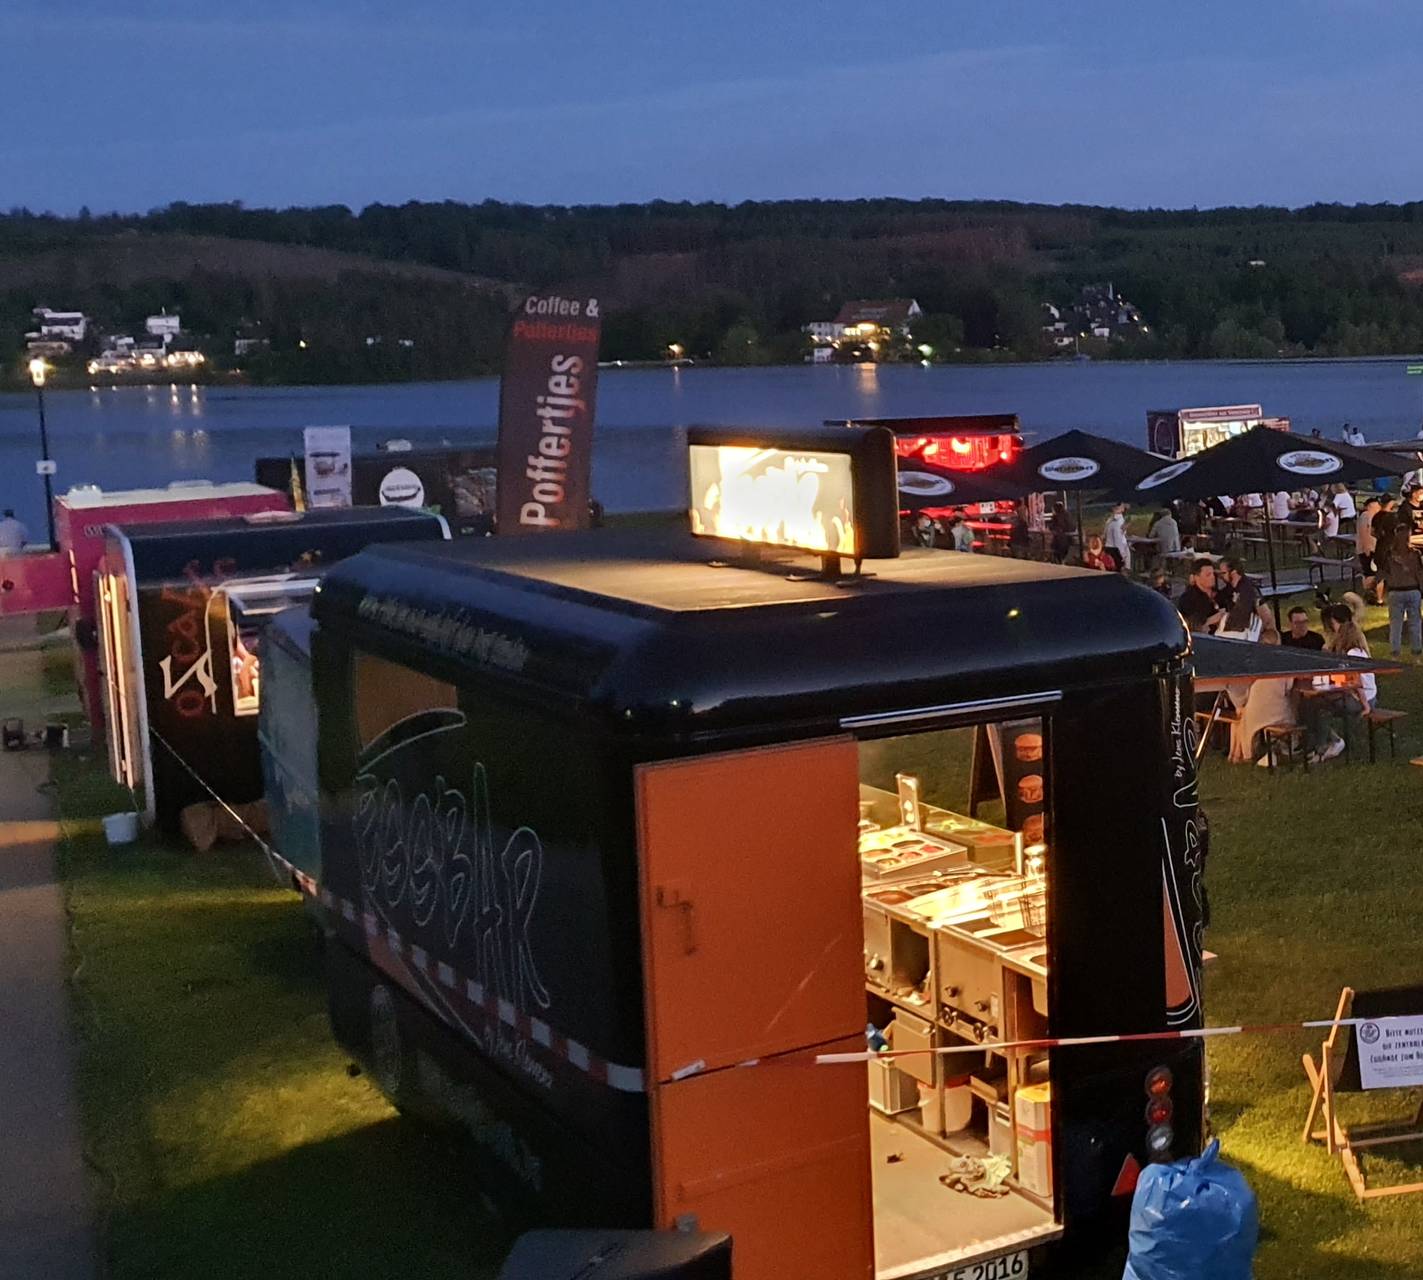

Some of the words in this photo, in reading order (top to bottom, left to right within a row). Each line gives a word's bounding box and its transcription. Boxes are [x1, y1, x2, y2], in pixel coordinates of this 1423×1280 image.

[525, 295, 580, 316] Coffee
[585, 297, 599, 318] &
[519, 353, 587, 528] Poffertjes
[1174, 764, 1186, 778] by
[972, 1253, 1024, 1280] 2016
